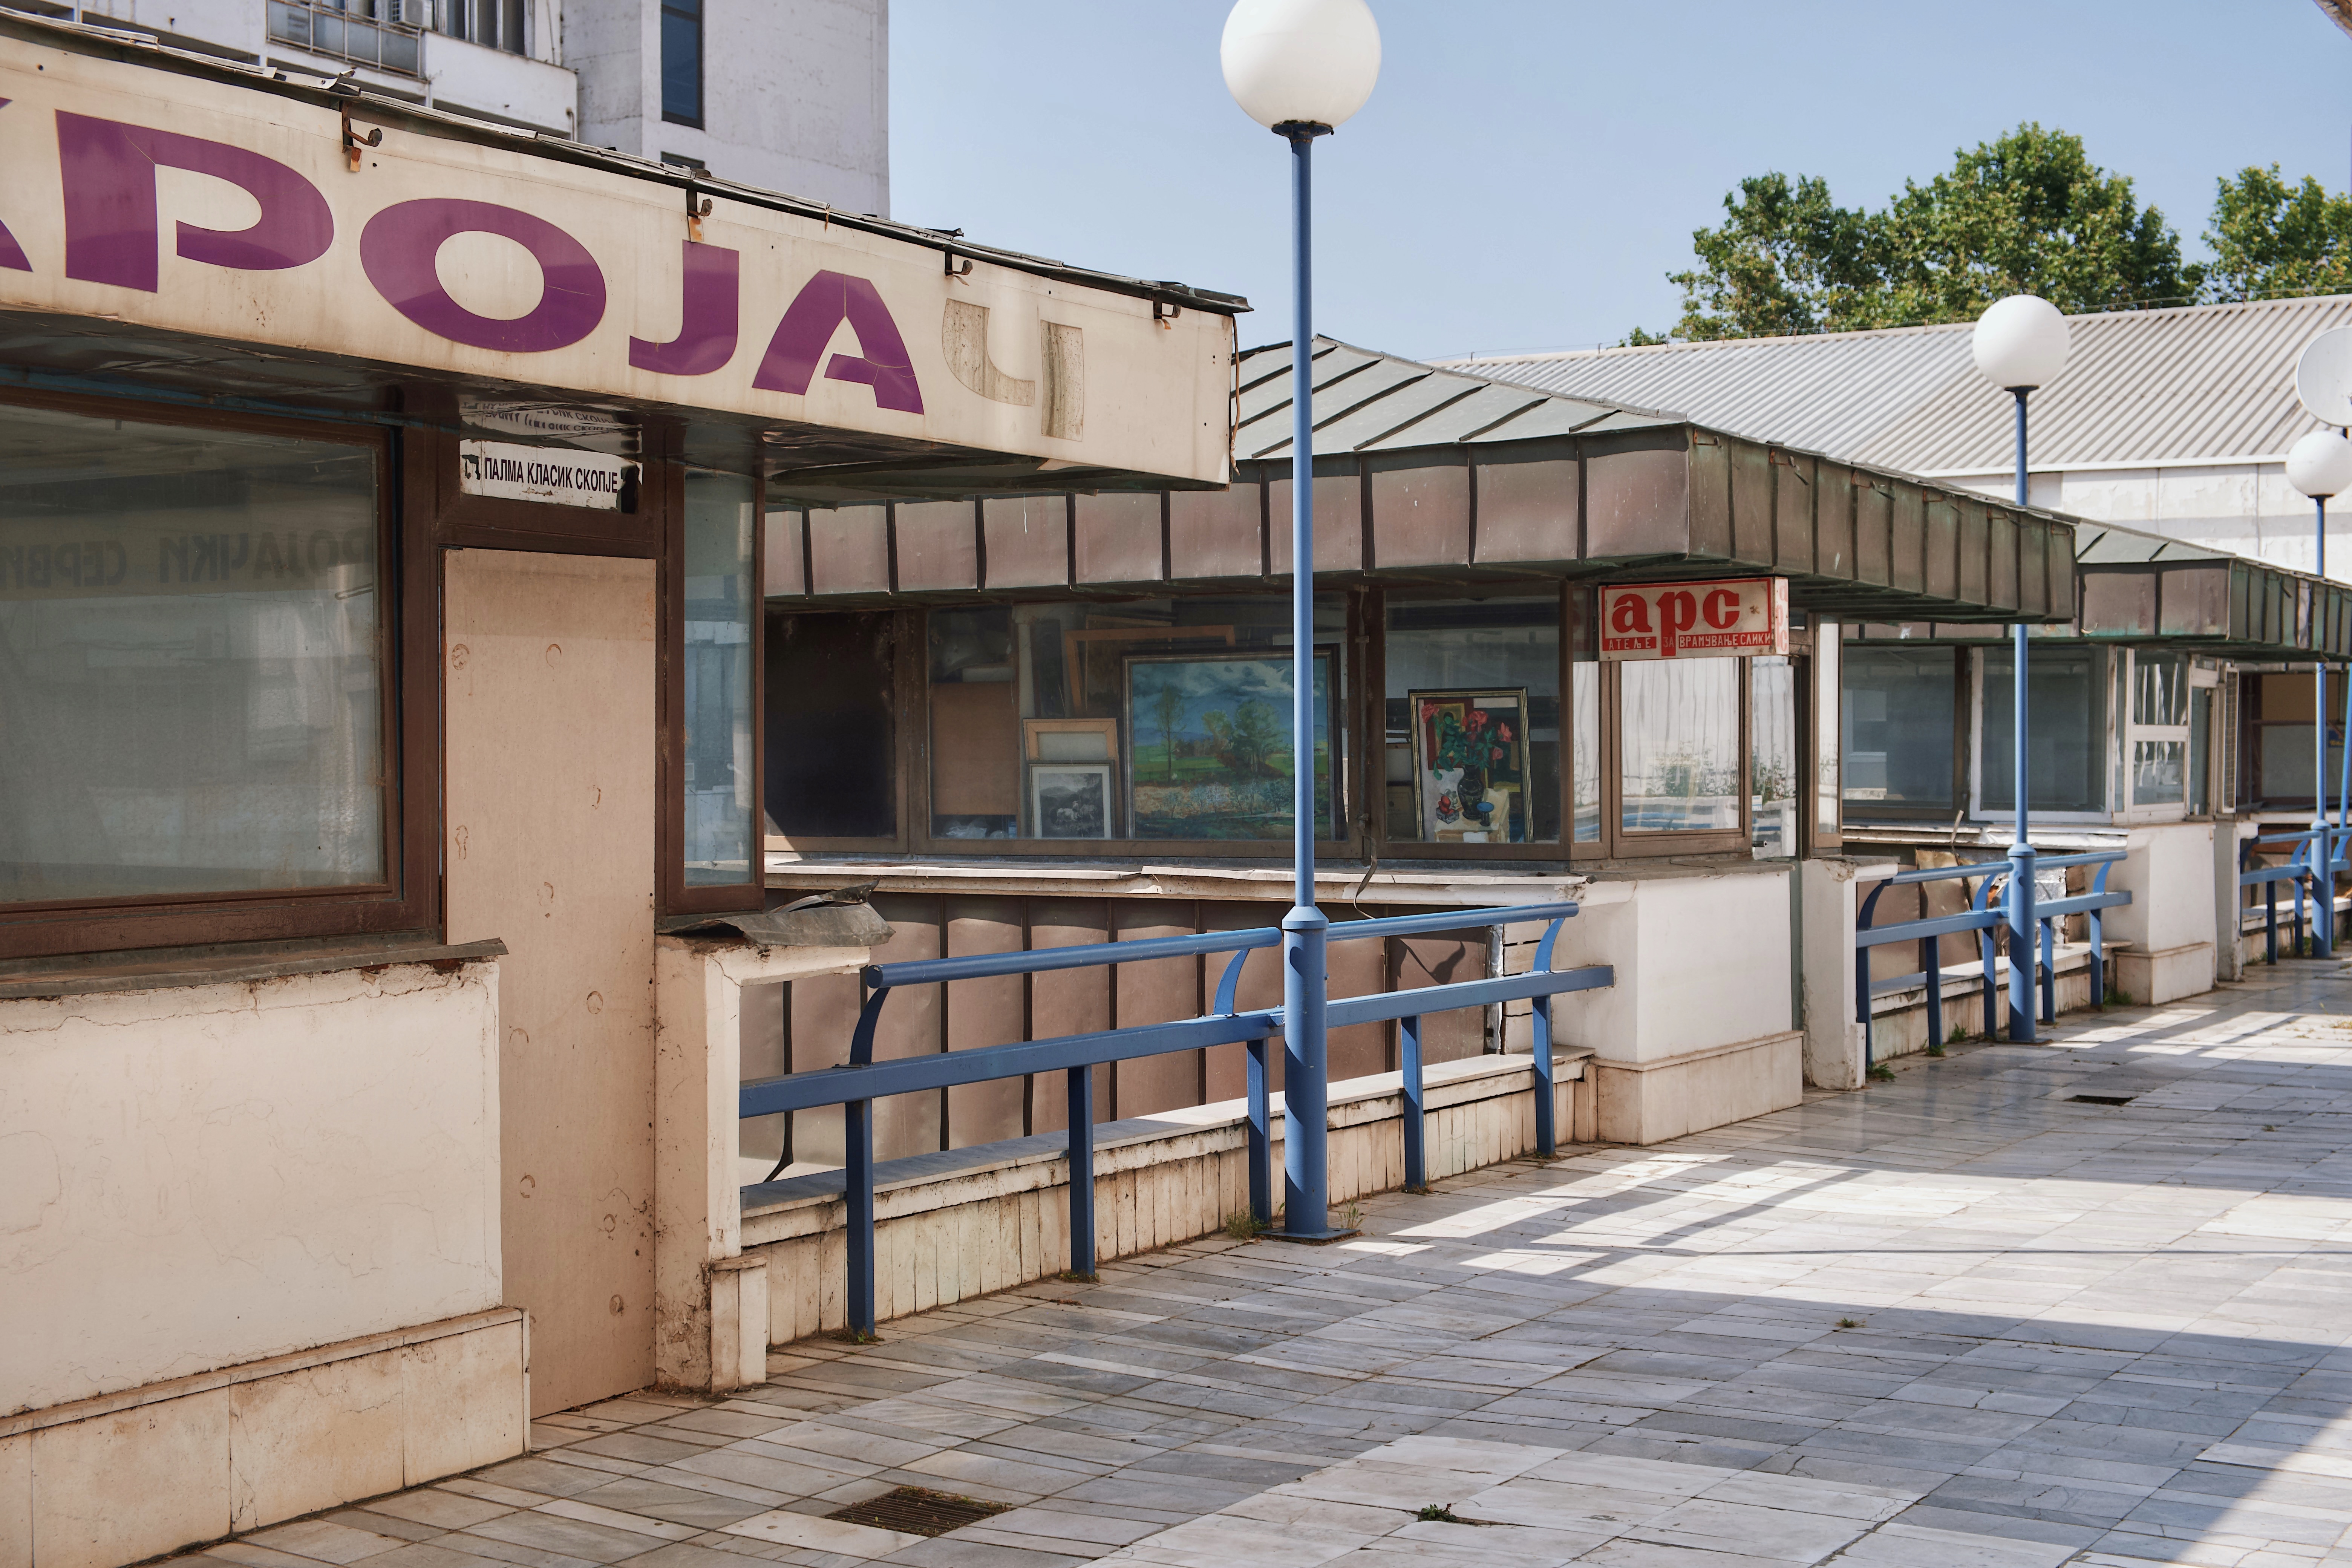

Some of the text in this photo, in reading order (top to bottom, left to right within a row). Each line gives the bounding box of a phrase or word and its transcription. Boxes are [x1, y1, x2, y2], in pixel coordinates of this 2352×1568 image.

[0, 98, 1084, 442] РОЈАЧ
[485, 457, 618, 493] ПАЛМА КЛАСИК СКОПЈЕ
[1608, 633, 1771, 650] АТЕЉЕ ЗА ВРАМУВАЊЕ СЛИКИ
